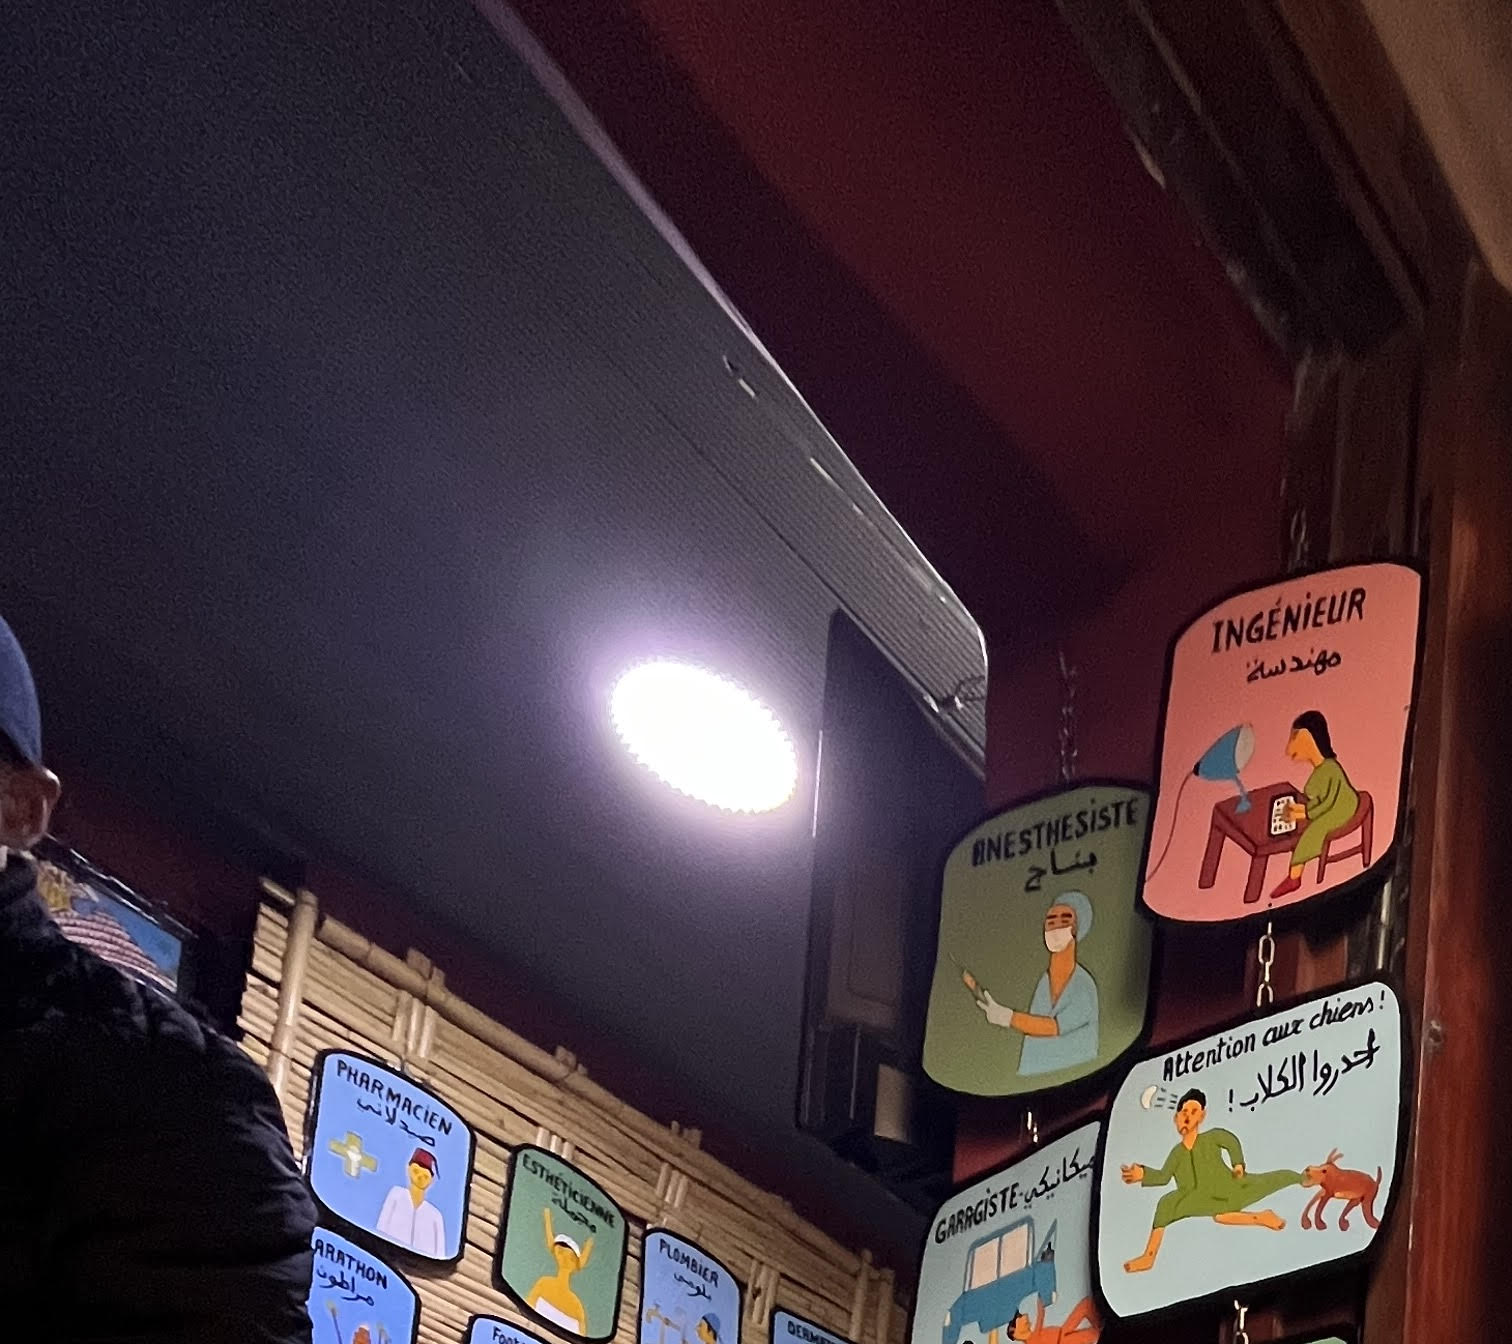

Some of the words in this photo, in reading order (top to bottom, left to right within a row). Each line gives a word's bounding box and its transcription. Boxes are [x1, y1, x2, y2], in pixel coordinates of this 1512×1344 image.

[1211, 587, 1366, 655] INGÉNIEUR
[971, 797, 1140, 868] ANESTHESISTE
[1162, 1032, 1256, 1083] Attention
[1262, 1017, 1304, 1049] aux
[337, 1059, 453, 1136] PHARMACIEN
[314, 1238, 388, 1290] ARATHON
[659, 1238, 719, 1289] PLOMBIER
